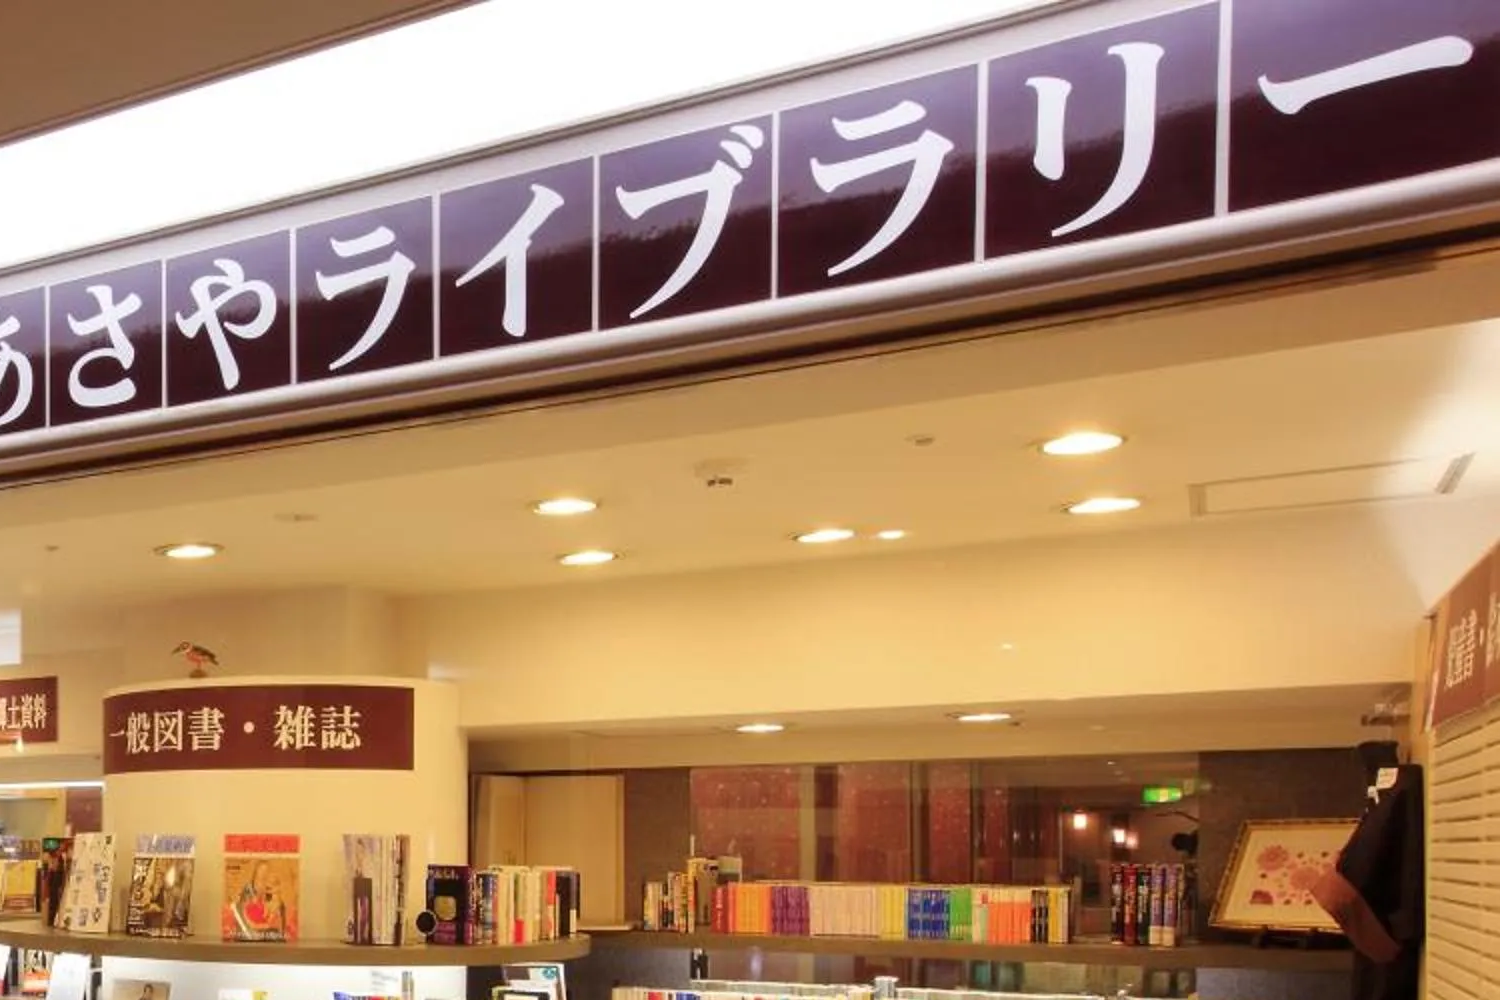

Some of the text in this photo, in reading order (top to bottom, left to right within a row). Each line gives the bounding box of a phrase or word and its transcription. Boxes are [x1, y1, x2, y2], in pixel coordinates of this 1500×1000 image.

[109, 705, 362, 754] 一般図書・雑誌
